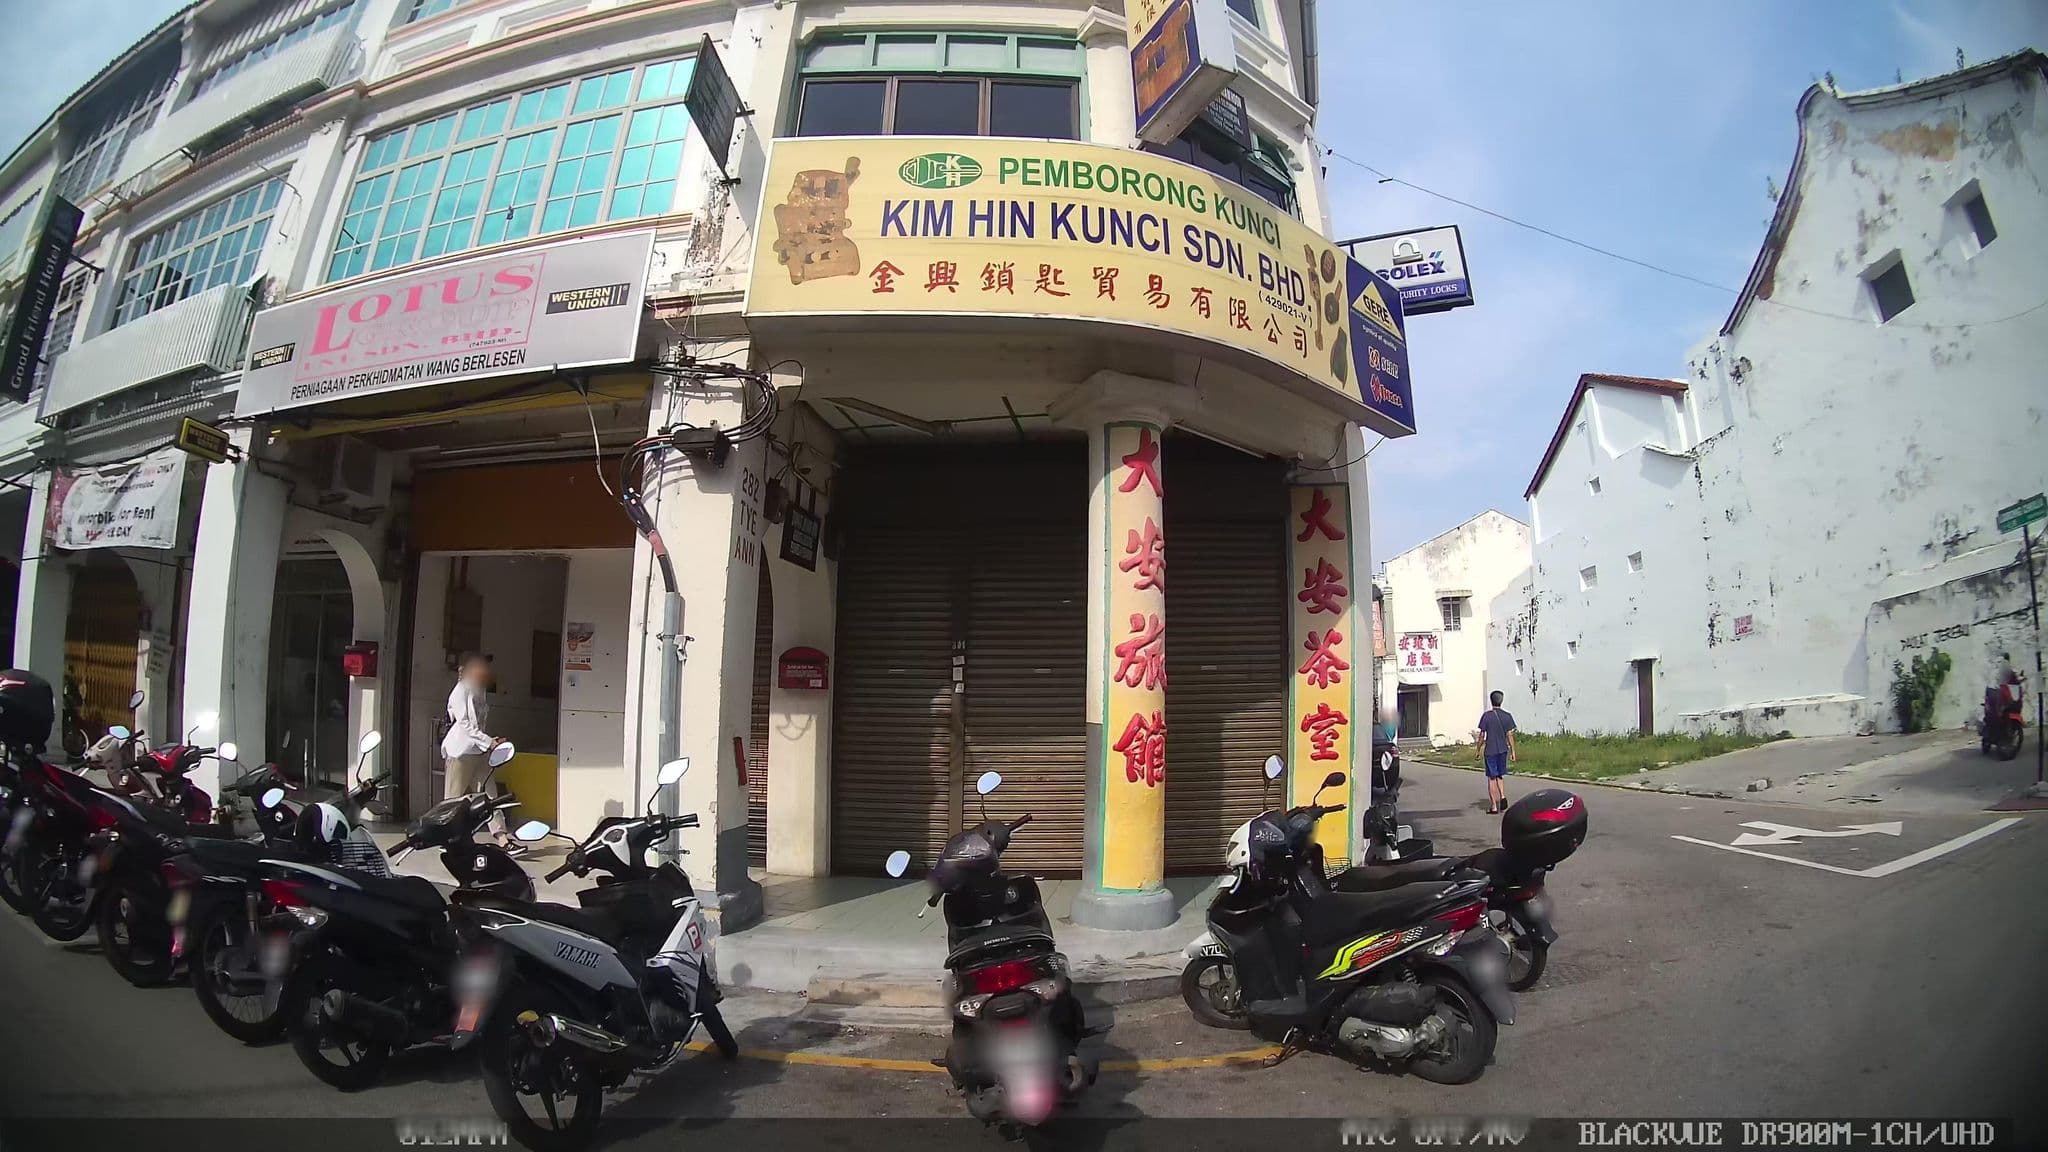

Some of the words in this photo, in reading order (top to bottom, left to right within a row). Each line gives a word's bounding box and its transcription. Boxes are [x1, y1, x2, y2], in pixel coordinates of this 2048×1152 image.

[999, 157, 1207, 213] PEMBORONG
[1214, 193, 1282, 250] KUNCI
[880, 200, 954, 238] KIM
[967, 200, 1035, 239] HIN
[1050, 202, 1171, 255] KUNCI
[1183, 224, 1253, 283] SDN.
[1258, 252, 1312, 312] BHD.
[1375, 261, 1447, 281] SOLEX
[552, 286, 611, 303] WESTERN
[567, 297, 610, 311] UNION
[1430, 284, 1458, 295] LOCKS
[11, 345, 31, 389] Good
[23, 288, 47, 340] Friend
[39, 244, 62, 291] Hotel
[310, 263, 535, 356] LOTUS
[1362, 294, 1390, 325] GERE
[253, 346, 285, 361] WESTERN
[260, 355, 284, 367] UNION
[291, 380, 346, 400] PERNIAGAAN
[347, 362, 423, 390] PERKHIDMATAN
[426, 357, 460, 377] WANG
[462, 348, 527, 372] BERLESEN
[742, 467, 760, 503] 282
[741, 500, 757, 536] TYE
[735, 535, 755, 567] ANN
[1113, 428, 1167, 788] 大安旅館
[1296, 487, 1350, 762] 大安茶室
[554, 941, 601, 969] YAMAHA
